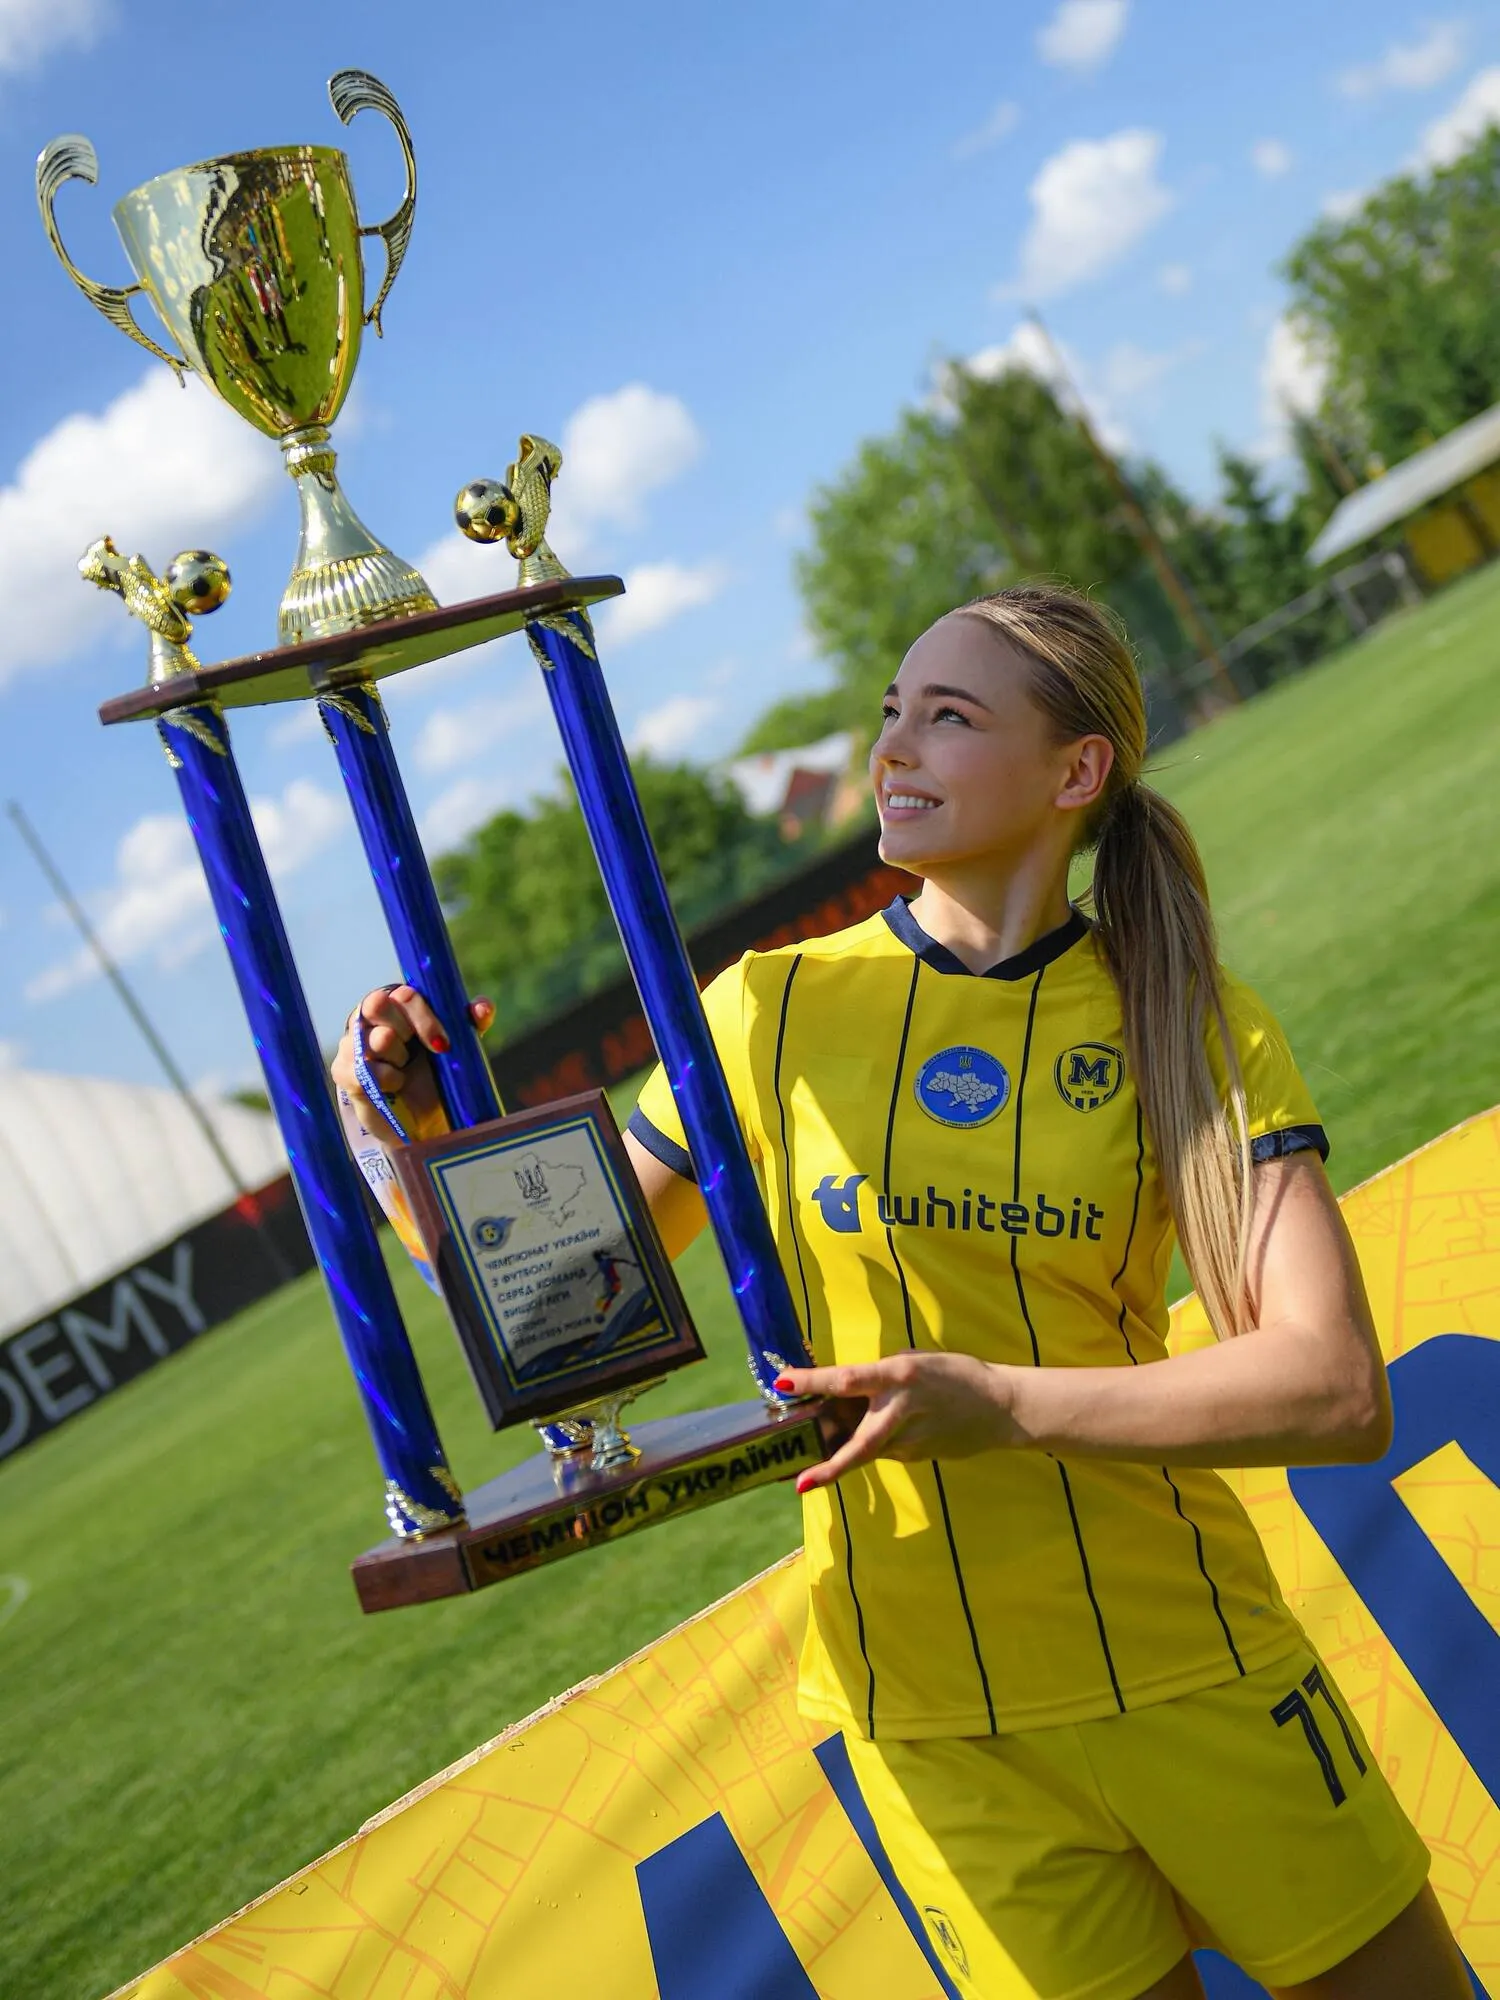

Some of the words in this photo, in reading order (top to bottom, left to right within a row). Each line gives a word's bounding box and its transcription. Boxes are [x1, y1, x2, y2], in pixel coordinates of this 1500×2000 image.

[1068, 1054, 1111, 1087] M
[877, 1186, 1104, 1240] whitebit
[482, 1487, 650, 1565] ЧЕМПІОН
[660, 1434, 806, 1502] УКРАЇНИ
